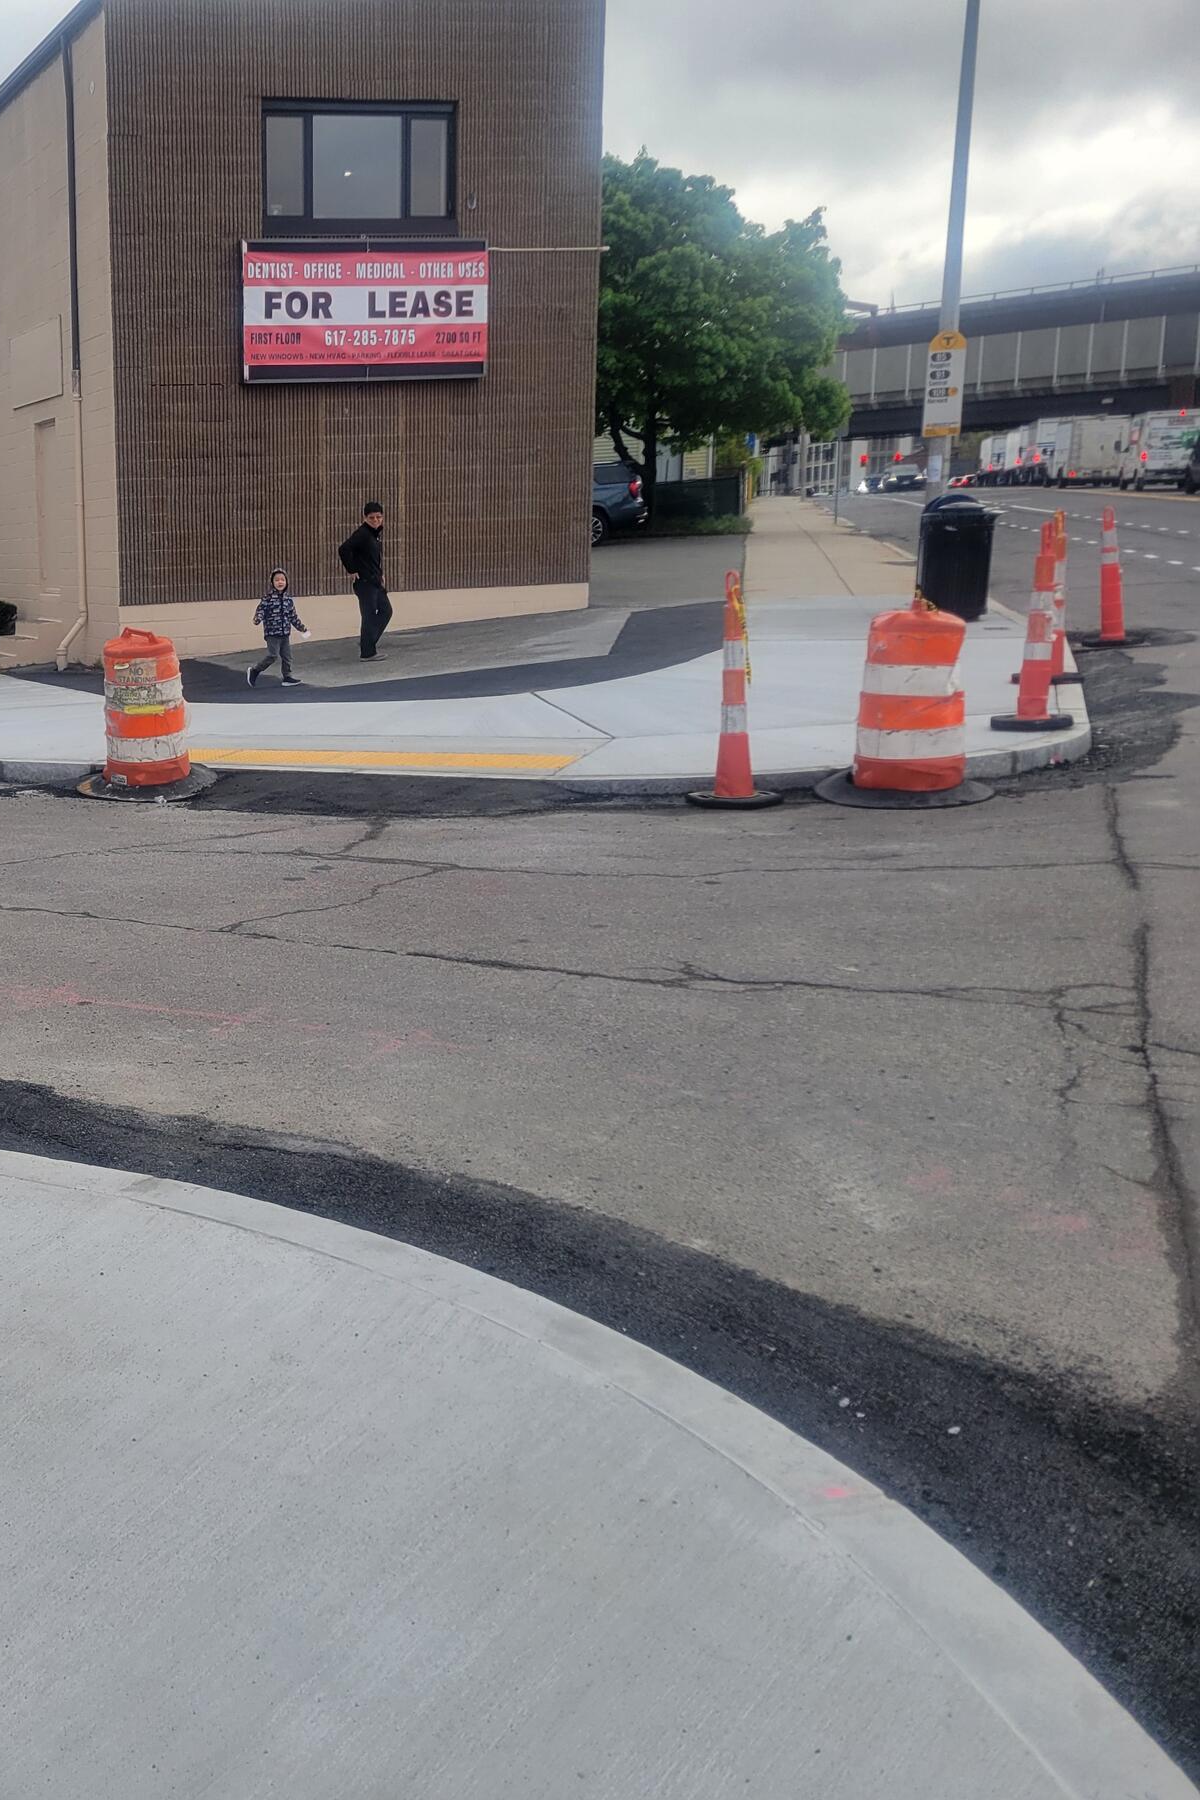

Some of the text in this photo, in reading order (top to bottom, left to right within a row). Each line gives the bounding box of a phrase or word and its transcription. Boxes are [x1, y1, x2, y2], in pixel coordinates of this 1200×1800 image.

[303, 262, 342, 279] OFFICE
[356, 262, 406, 279] MEDICAL
[419, 262, 454, 279] OTHER
[458, 261, 485, 278] USES
[264, 290, 474, 320] FOR LEASE
[250, 332, 301, 345] FIRST FLOOR
[324, 329, 416, 346] 617-285-7875
[435, 331, 481, 344] 2700 SQ FT
[309, 352, 326, 360] NEW
[326, 352, 347, 360] HVAC
[129, 667, 144, 676] NO
